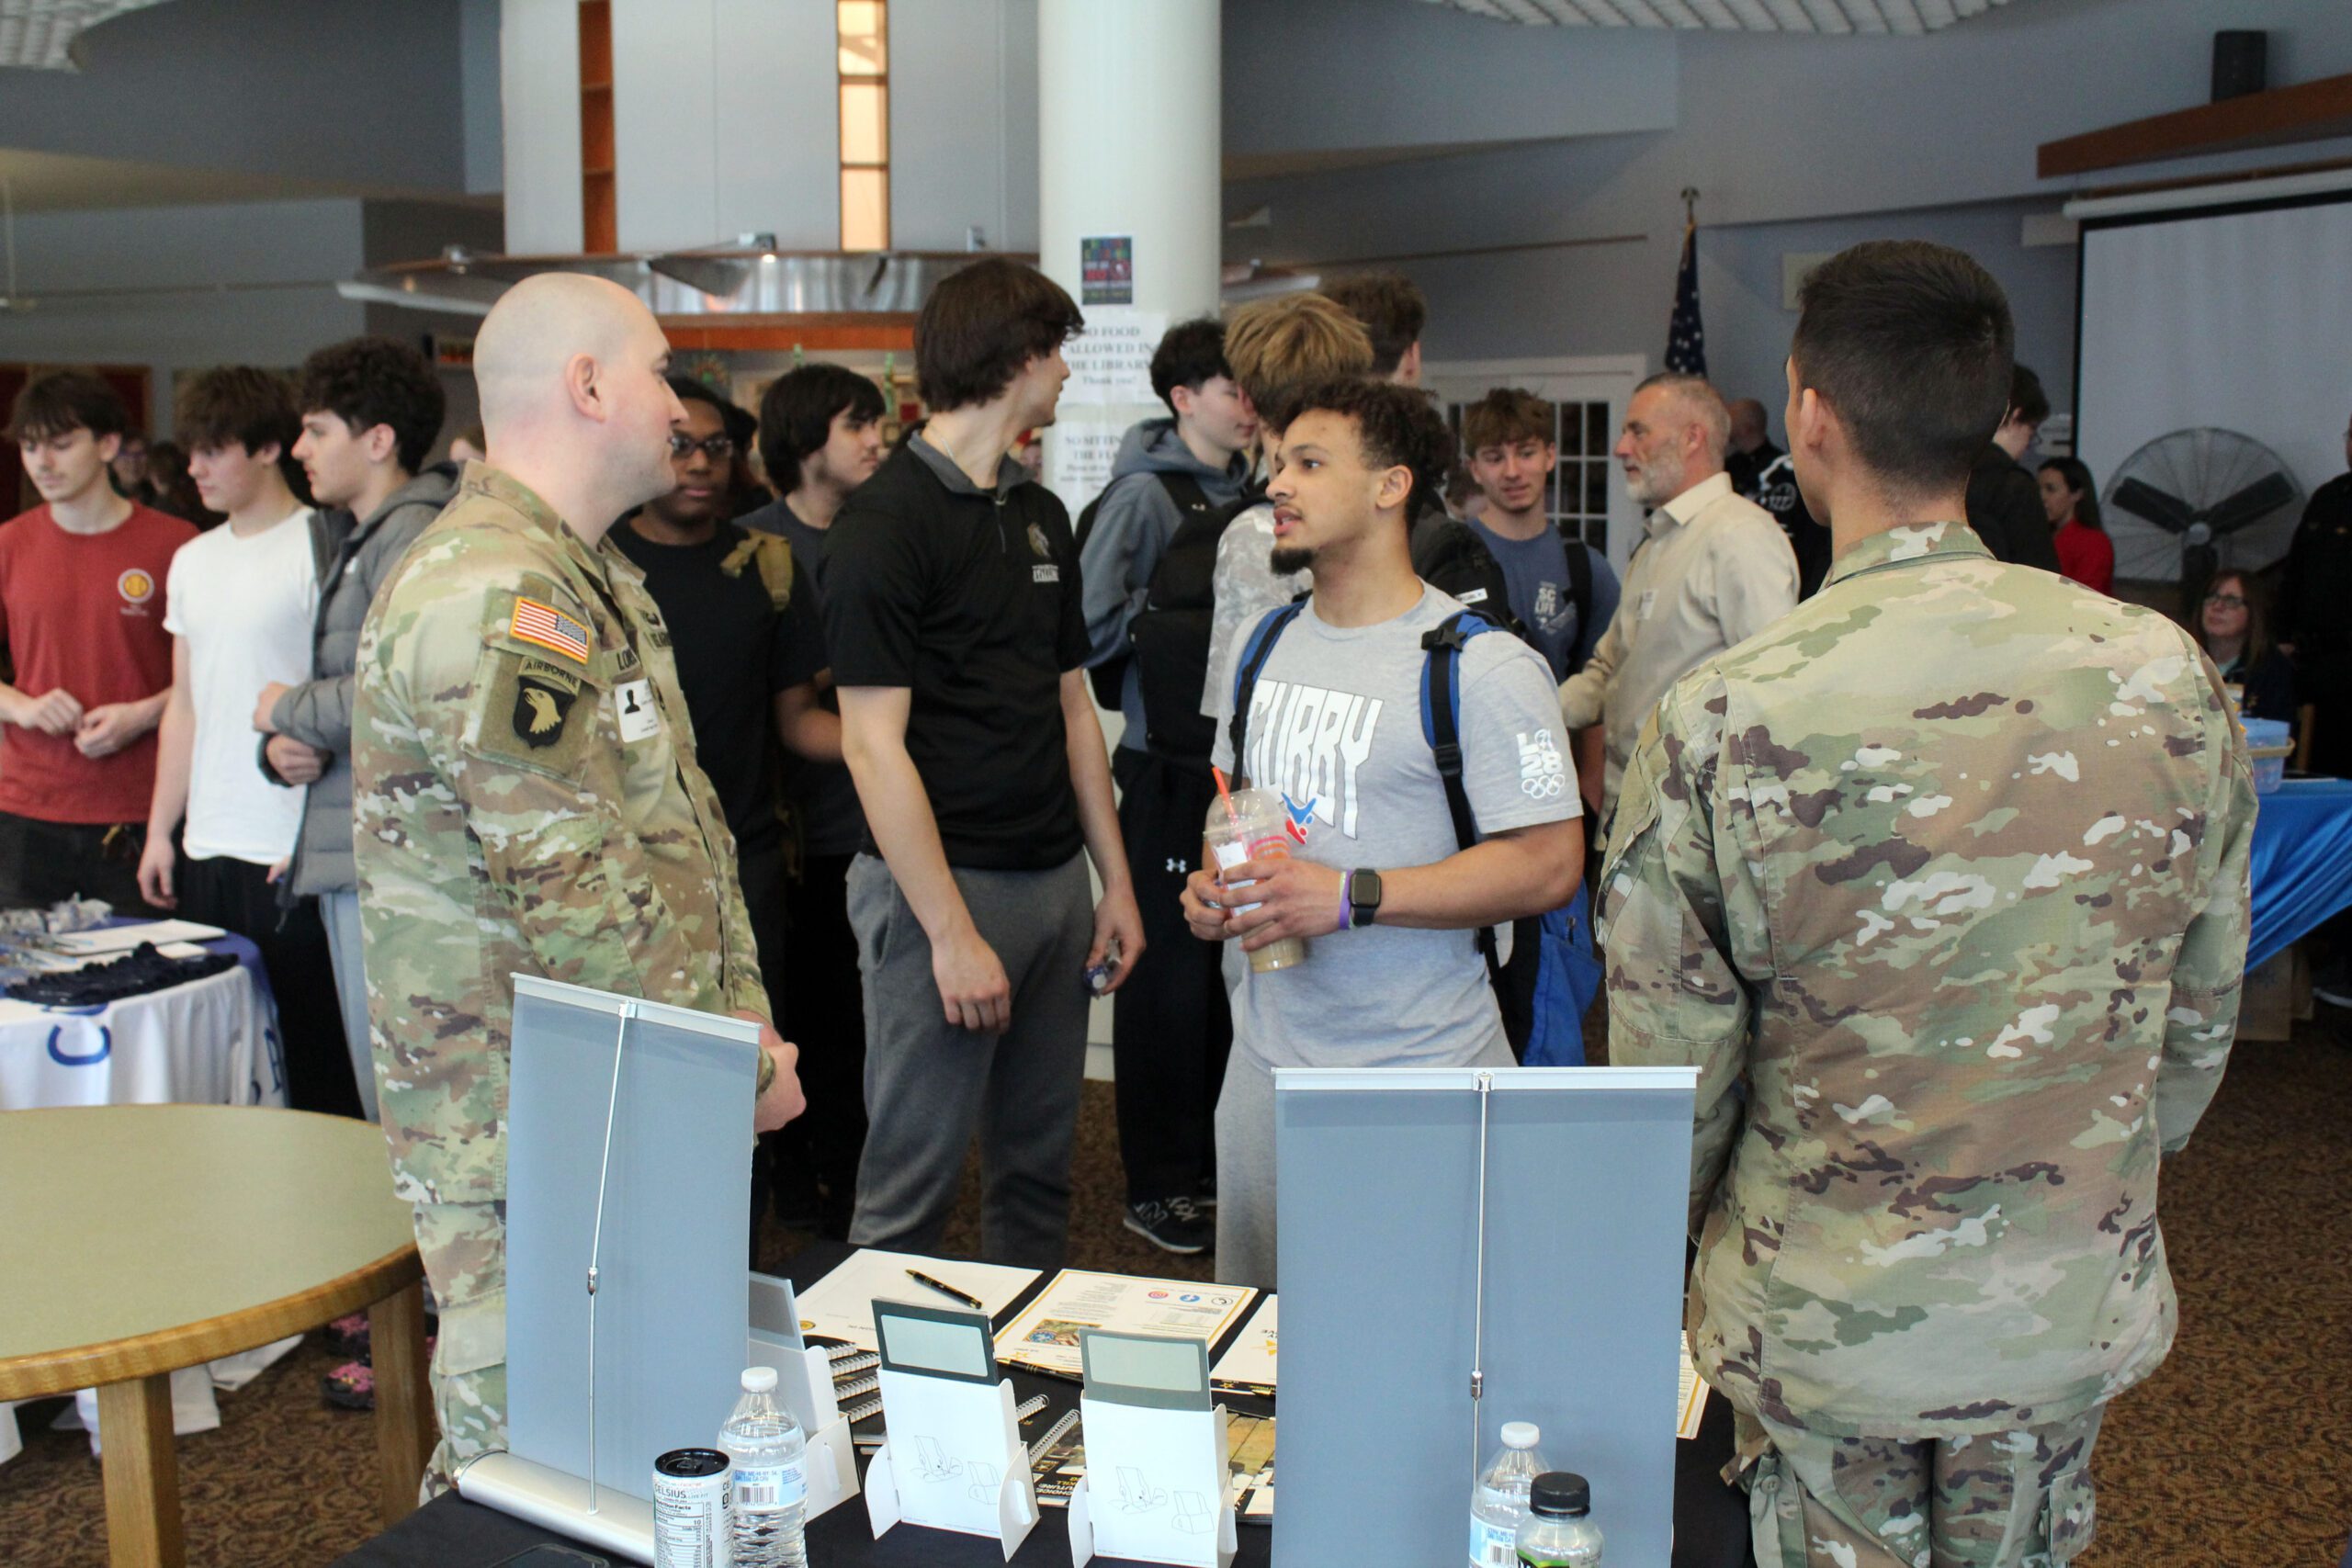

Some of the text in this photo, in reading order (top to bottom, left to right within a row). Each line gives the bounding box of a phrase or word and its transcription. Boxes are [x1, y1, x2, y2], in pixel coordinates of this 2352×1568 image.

[1102, 327, 1141, 337] FOOD
[1069, 343, 1135, 354] ALLOWED
[1091, 360, 1150, 370] LIBRARY
[525, 660, 579, 688] AIRBORNE
[654, 1483, 687, 1500] CELSIUS
